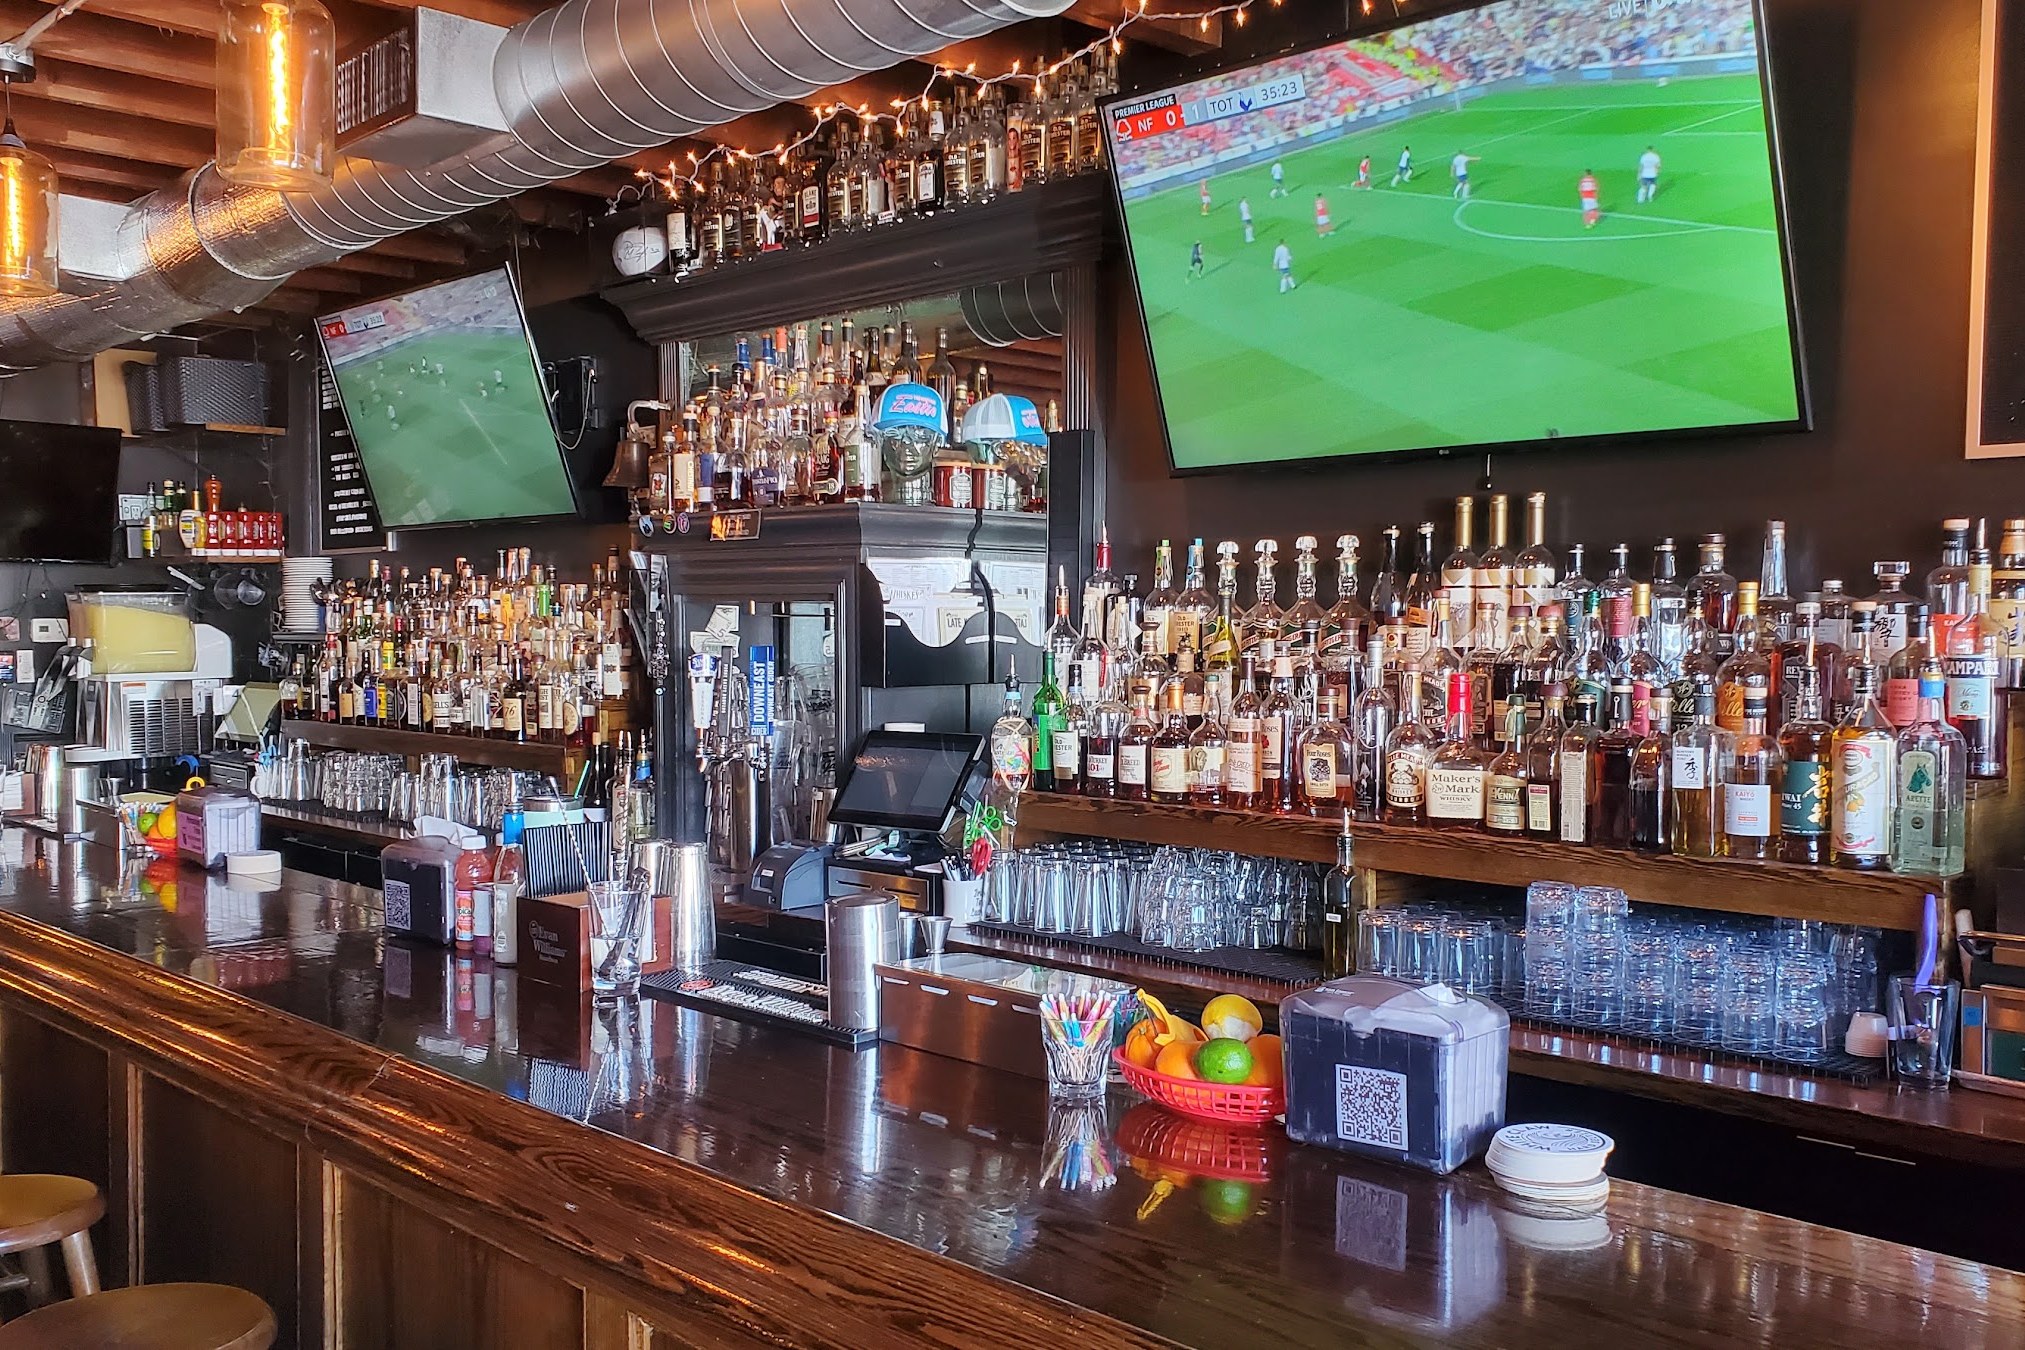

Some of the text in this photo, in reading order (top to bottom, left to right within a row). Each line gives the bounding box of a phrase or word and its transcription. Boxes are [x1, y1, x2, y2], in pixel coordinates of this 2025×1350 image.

[1114, 94, 1175, 119] PREMIER LEAGUE
[1137, 117, 1153, 133] NF
[1166, 110, 1176, 126] 0
[1209, 97, 1233, 114] TOT
[1261, 82, 1297, 101] 35:23
[947, 619, 962, 628] LATE
[1947, 660, 2000, 676] AMPARI
[753, 661, 767, 723] DOWNEAST
[751, 727, 768, 736] CIDER
[1431, 774, 1481, 783] Maker's
[1445, 785, 1480, 794] Mark
